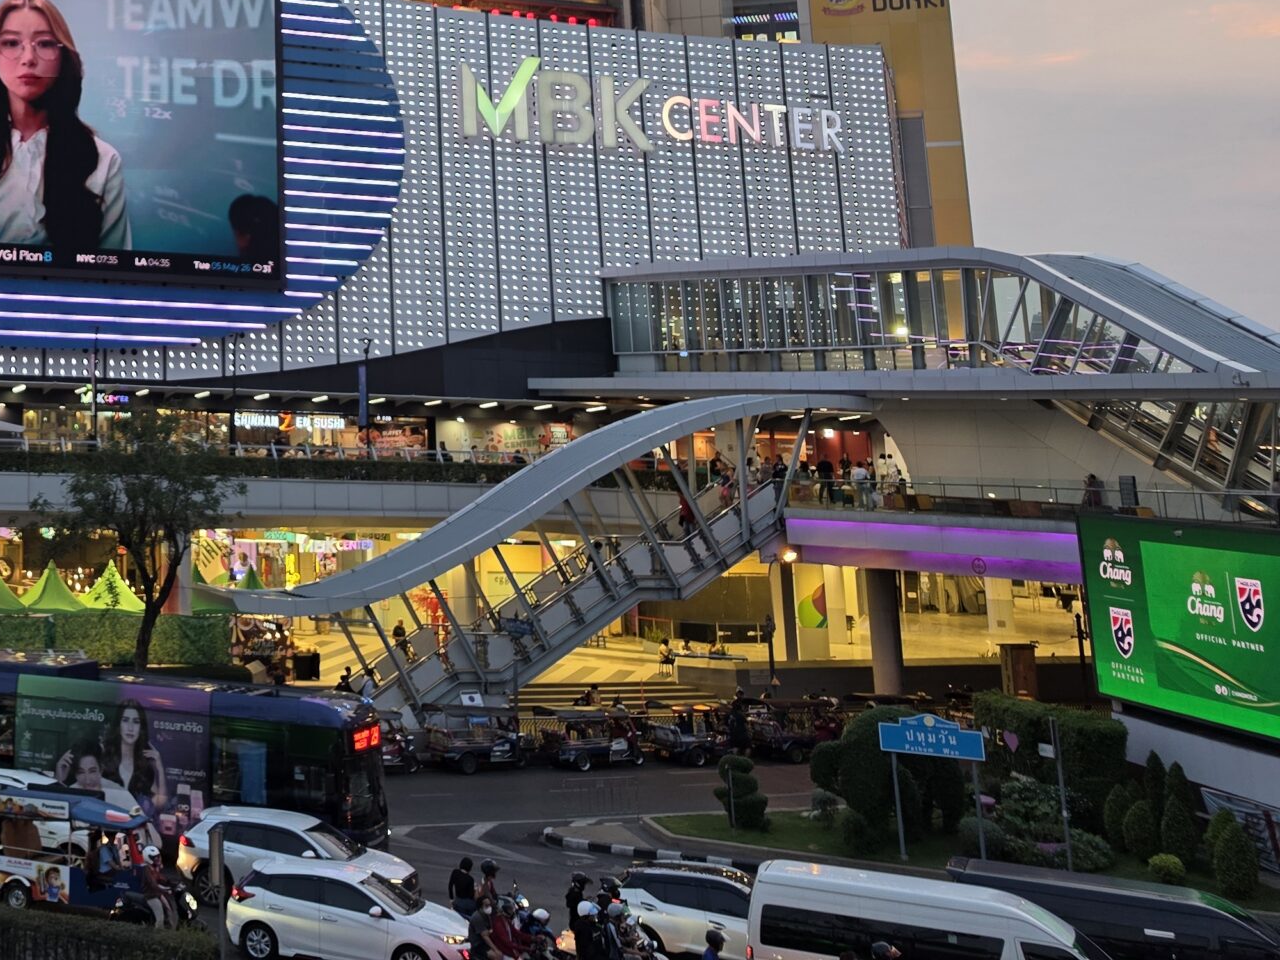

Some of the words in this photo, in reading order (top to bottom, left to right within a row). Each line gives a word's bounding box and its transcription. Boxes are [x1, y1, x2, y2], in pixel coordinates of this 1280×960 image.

[118, 56, 198, 105] THE
[461, 57, 656, 152] MBK
[662, 95, 845, 154] CENTER
[76, 254, 95, 263] NYC
[135, 257, 147, 266] LA
[193, 260, 211, 270] Tue
[313, 417, 345, 429] SUSHI
[336, 540, 373, 551] CENTER
[1100, 561, 1132, 585] Chang
[1187, 595, 1224, 622] Chang
[1195, 632, 1227, 646] OFFICIAL
[1232, 639, 1265, 653] PARTNER
[1111, 661, 1144, 676] OFFICIAL
[1112, 671, 1145, 684] PARTNER
[905, 730, 958, 746] ปทุมวัน
